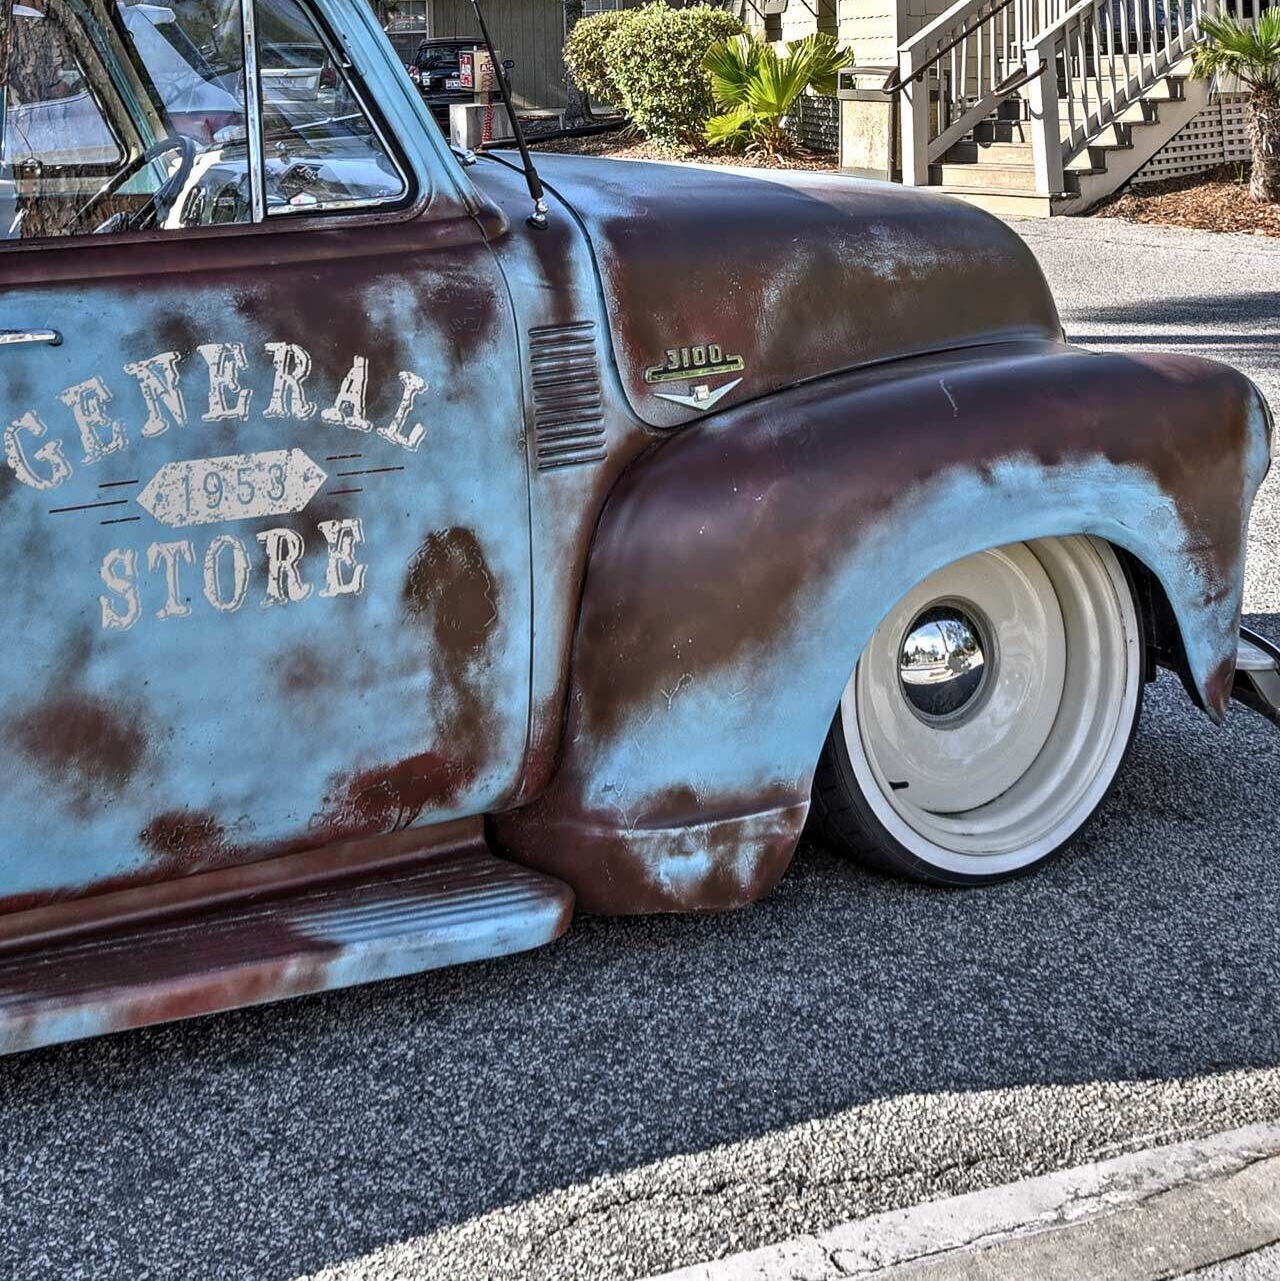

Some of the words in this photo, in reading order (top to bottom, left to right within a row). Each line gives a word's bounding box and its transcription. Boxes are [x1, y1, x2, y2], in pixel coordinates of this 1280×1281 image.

[666, 344, 723, 369] 3100
[3, 341, 428, 490] GENERAL
[182, 463, 286, 512] 1953
[99, 518, 368, 631] STORE
